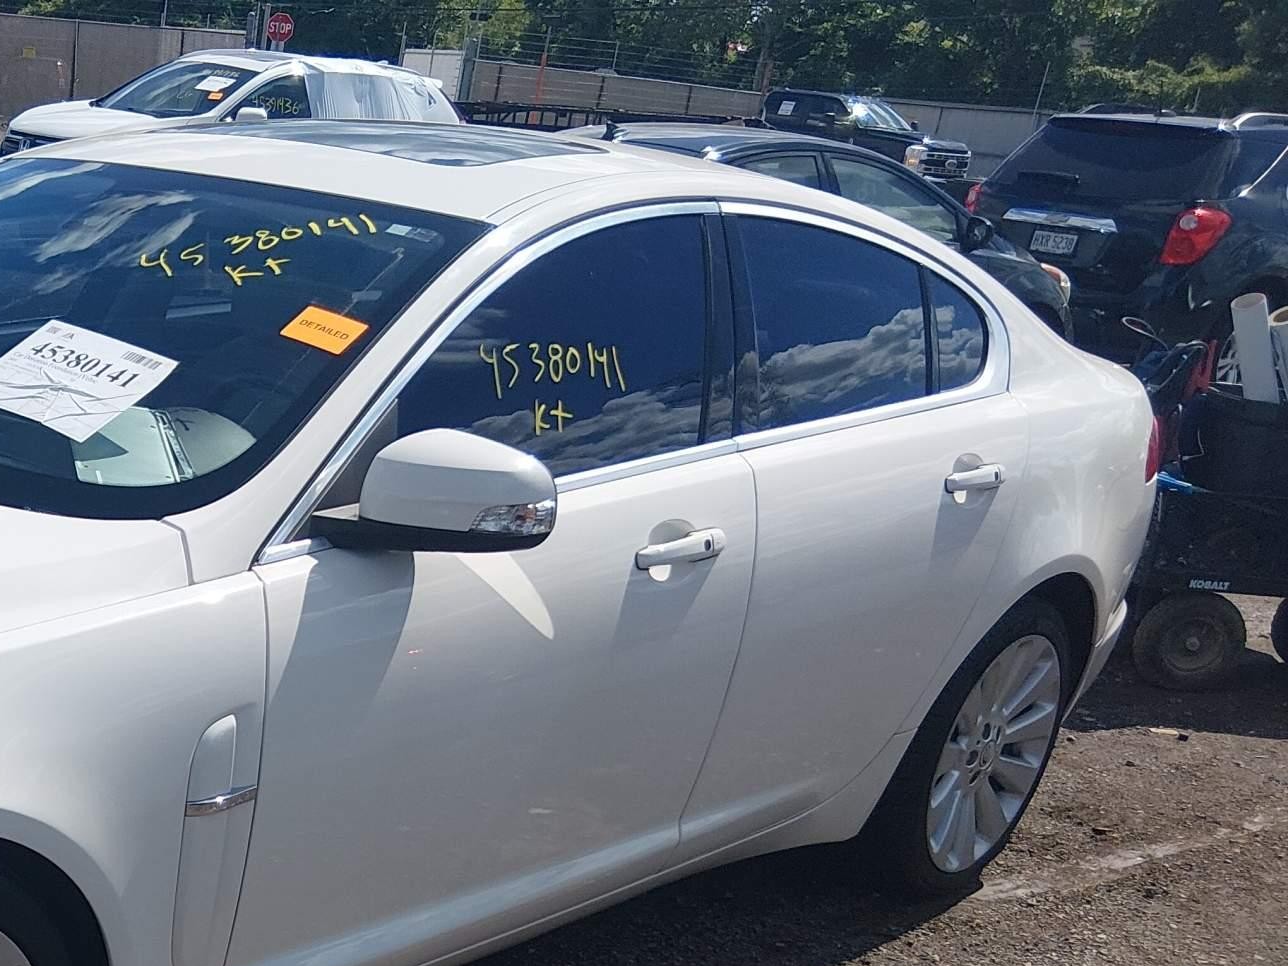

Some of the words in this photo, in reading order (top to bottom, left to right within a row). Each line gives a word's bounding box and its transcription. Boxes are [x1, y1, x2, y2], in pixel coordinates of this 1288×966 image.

[268, 22, 292, 34] STOP
[298, 318, 349, 341] DETAILED
[31, 341, 142, 388] 45380141
[1189, 579, 1230, 591] KOBALT
